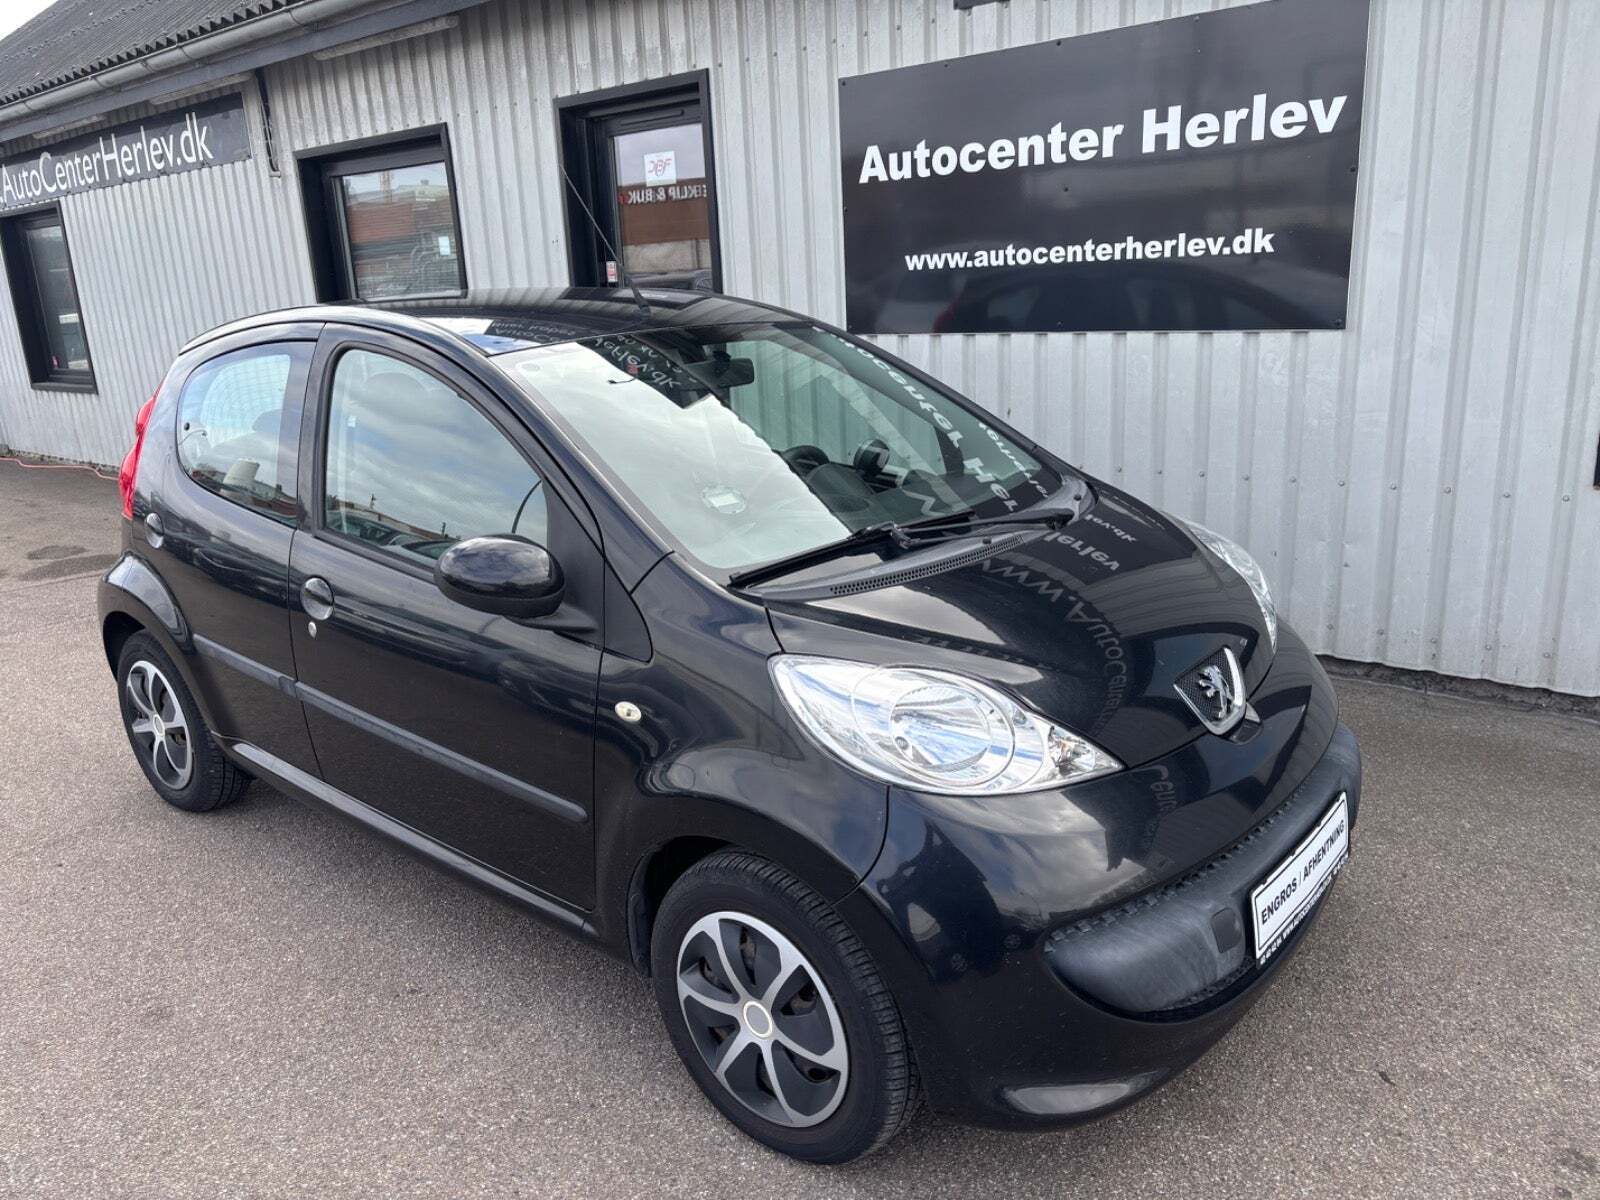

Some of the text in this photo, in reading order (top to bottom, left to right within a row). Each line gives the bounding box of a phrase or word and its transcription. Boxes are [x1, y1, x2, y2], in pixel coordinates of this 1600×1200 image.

[859, 93, 1348, 185] Autocenter Herlev
[905, 227, 1275, 271] www.autocenterherlev.dk
[1261, 877, 1298, 925] ENGROS
[1303, 819, 1345, 881] AFHENTNING
